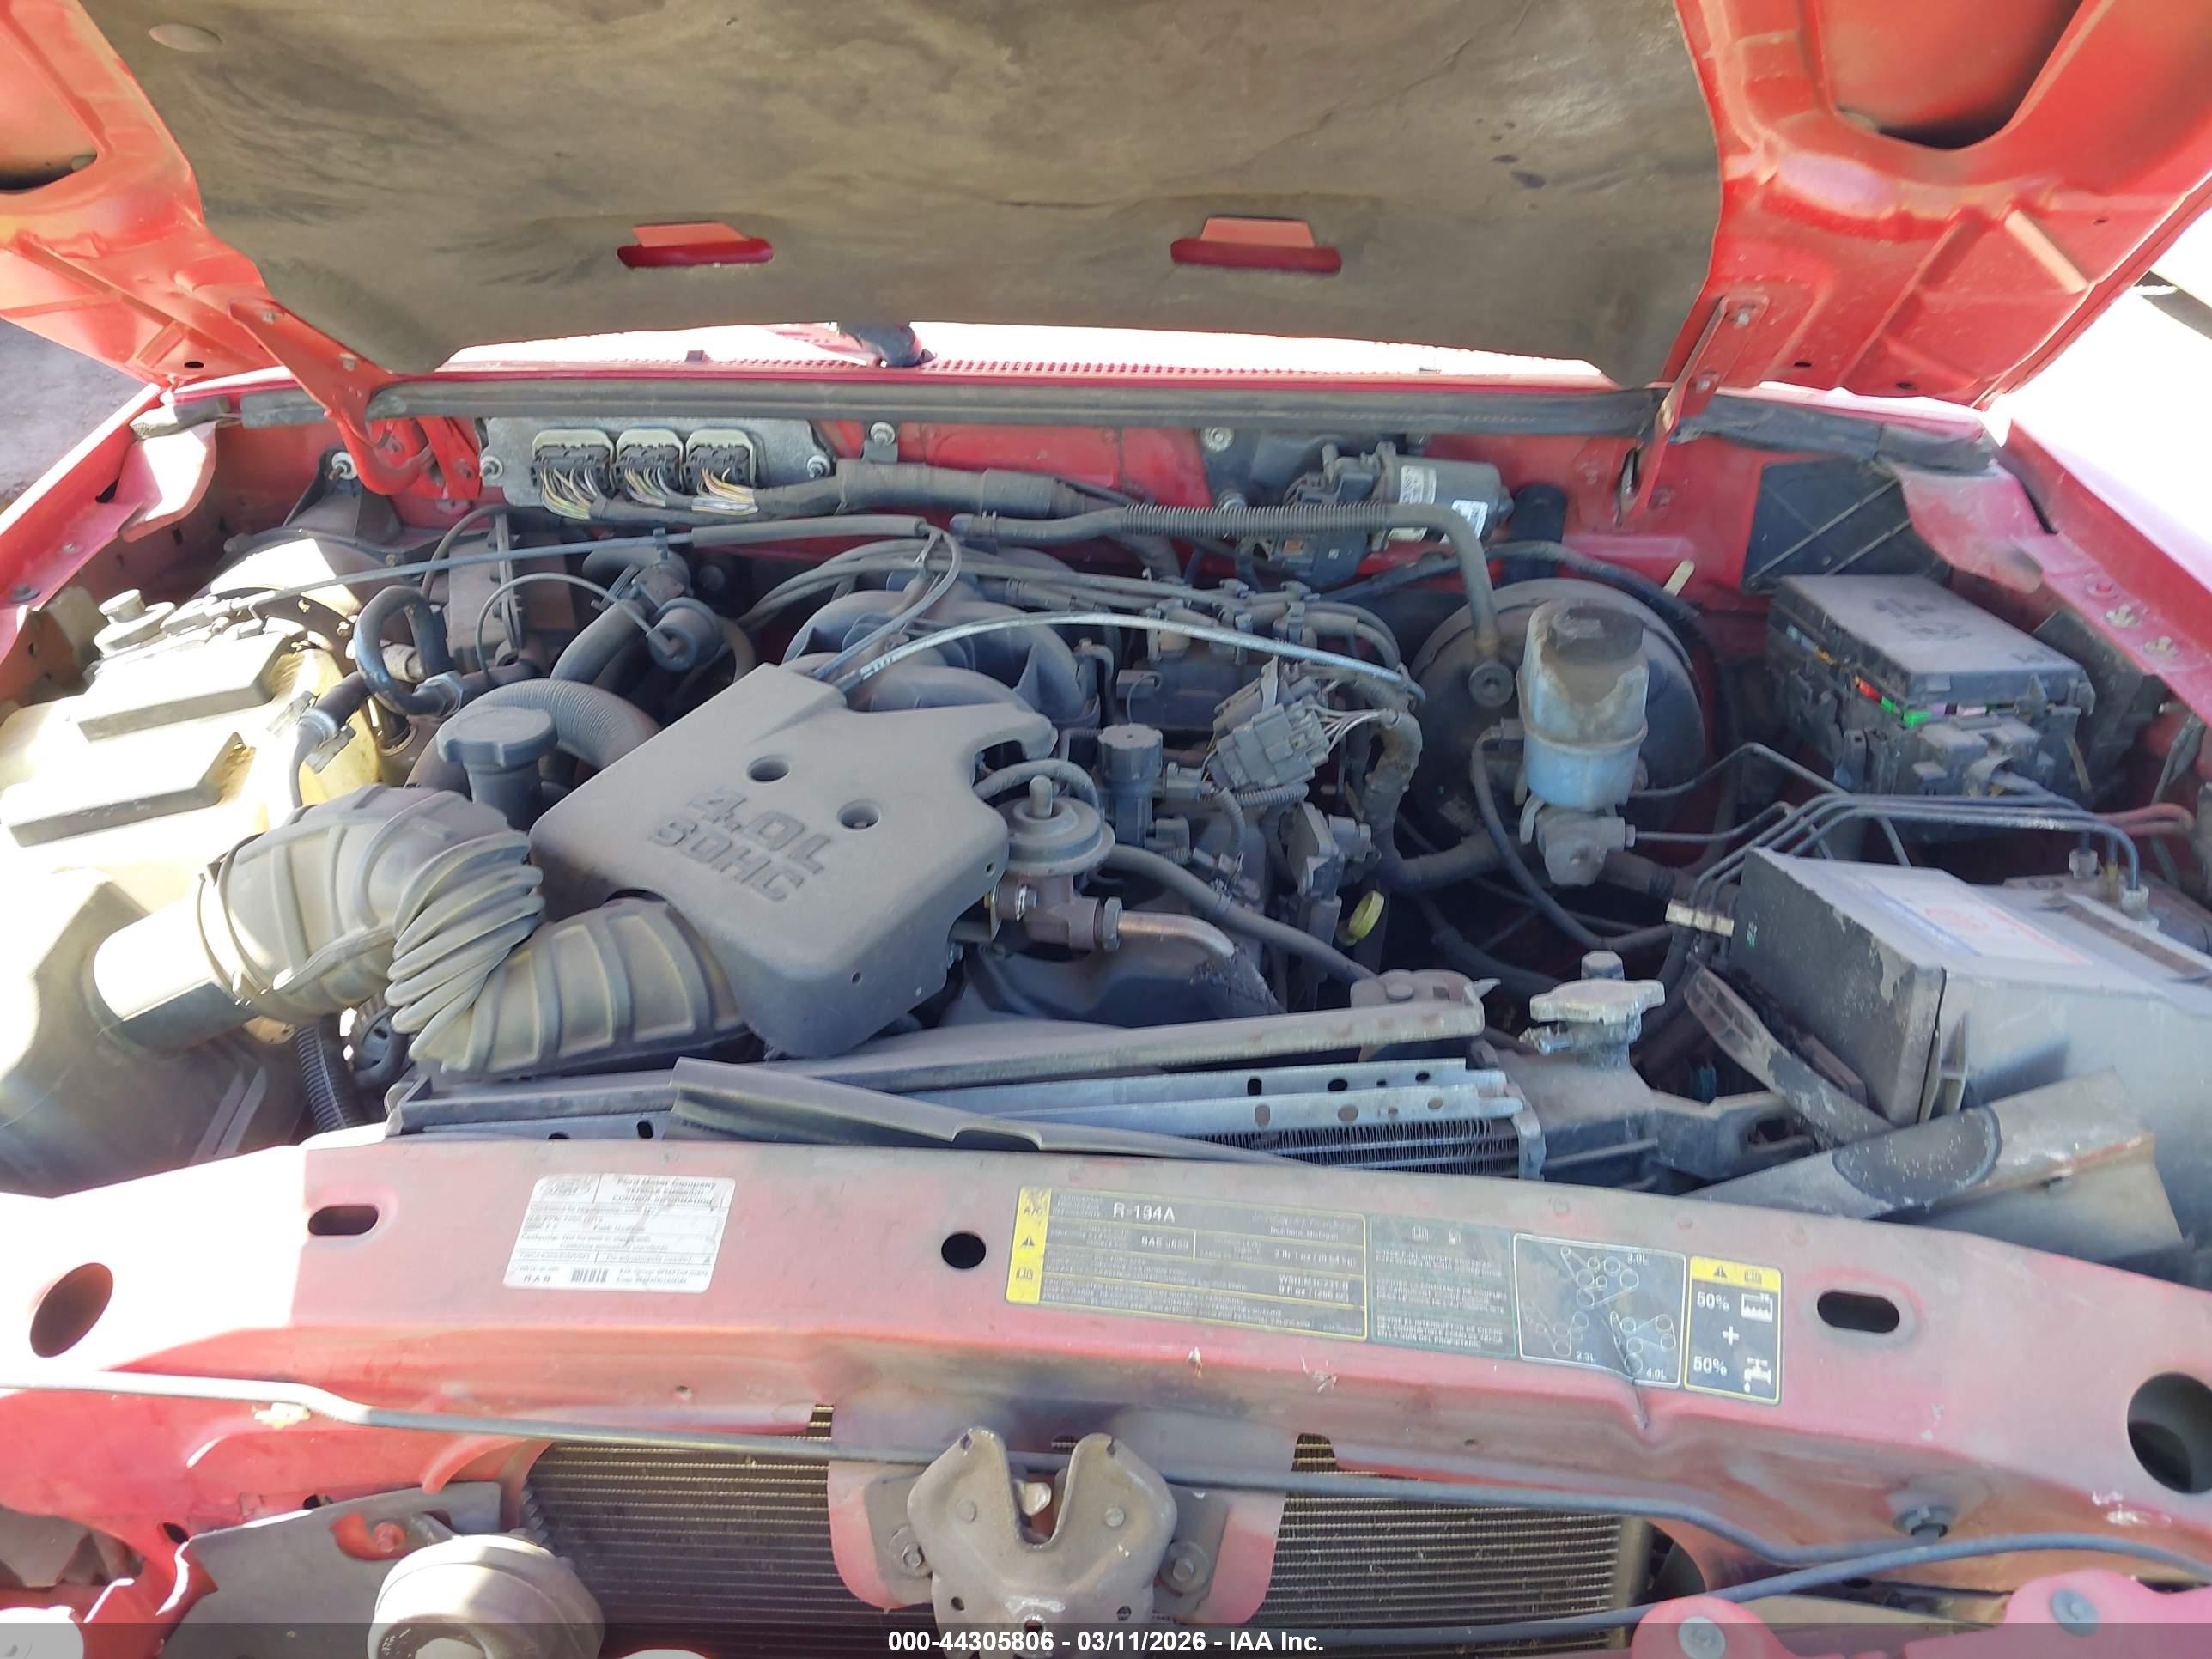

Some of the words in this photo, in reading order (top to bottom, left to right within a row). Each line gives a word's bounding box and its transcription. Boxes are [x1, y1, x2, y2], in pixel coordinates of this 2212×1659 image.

[688, 786, 834, 875] 4.0L
[649, 818, 805, 902] SOHC
[1113, 1201, 1176, 1223] R-134A
[1697, 1291, 1730, 1312] 50%
[1646, 1368, 1667, 1382] 4.0L
[1693, 1357, 1728, 1376] 50%
